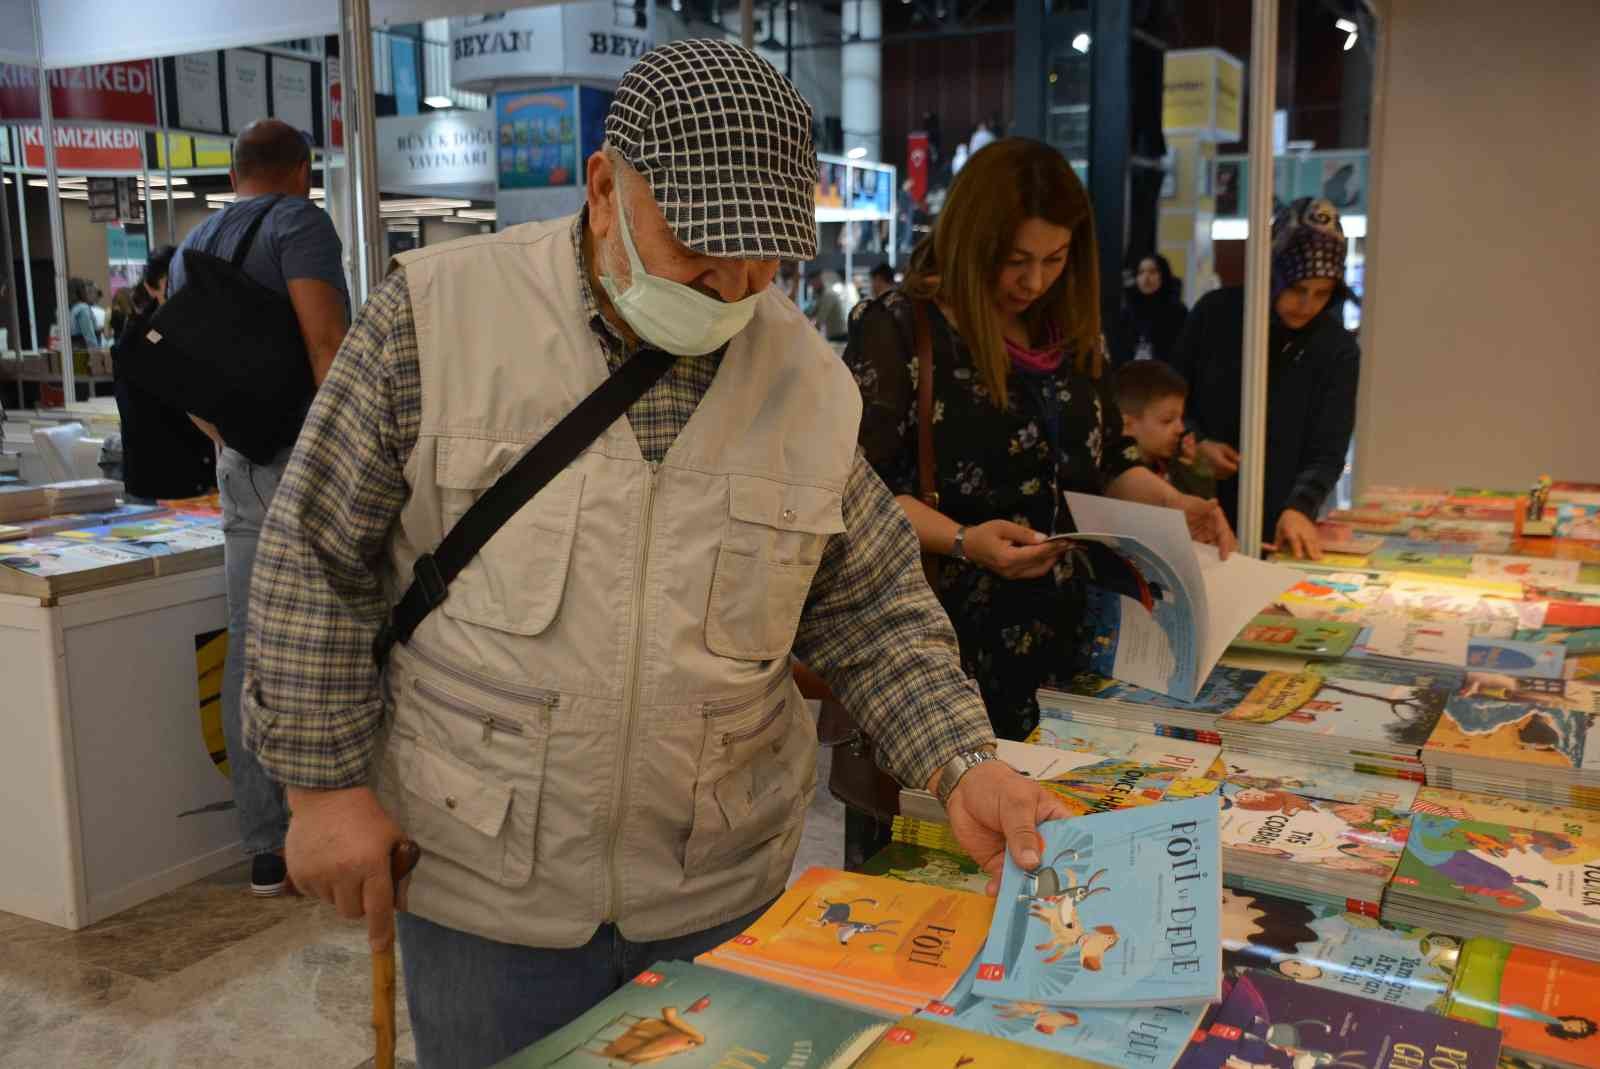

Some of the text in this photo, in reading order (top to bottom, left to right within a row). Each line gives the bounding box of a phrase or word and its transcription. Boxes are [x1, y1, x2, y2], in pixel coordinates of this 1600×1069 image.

[454, 29, 533, 61] BEYAN
[1166, 821, 1209, 884] PÖTİ
[1164, 906, 1201, 976] DEDE
[1382, 957, 1422, 1003] Yemğini
